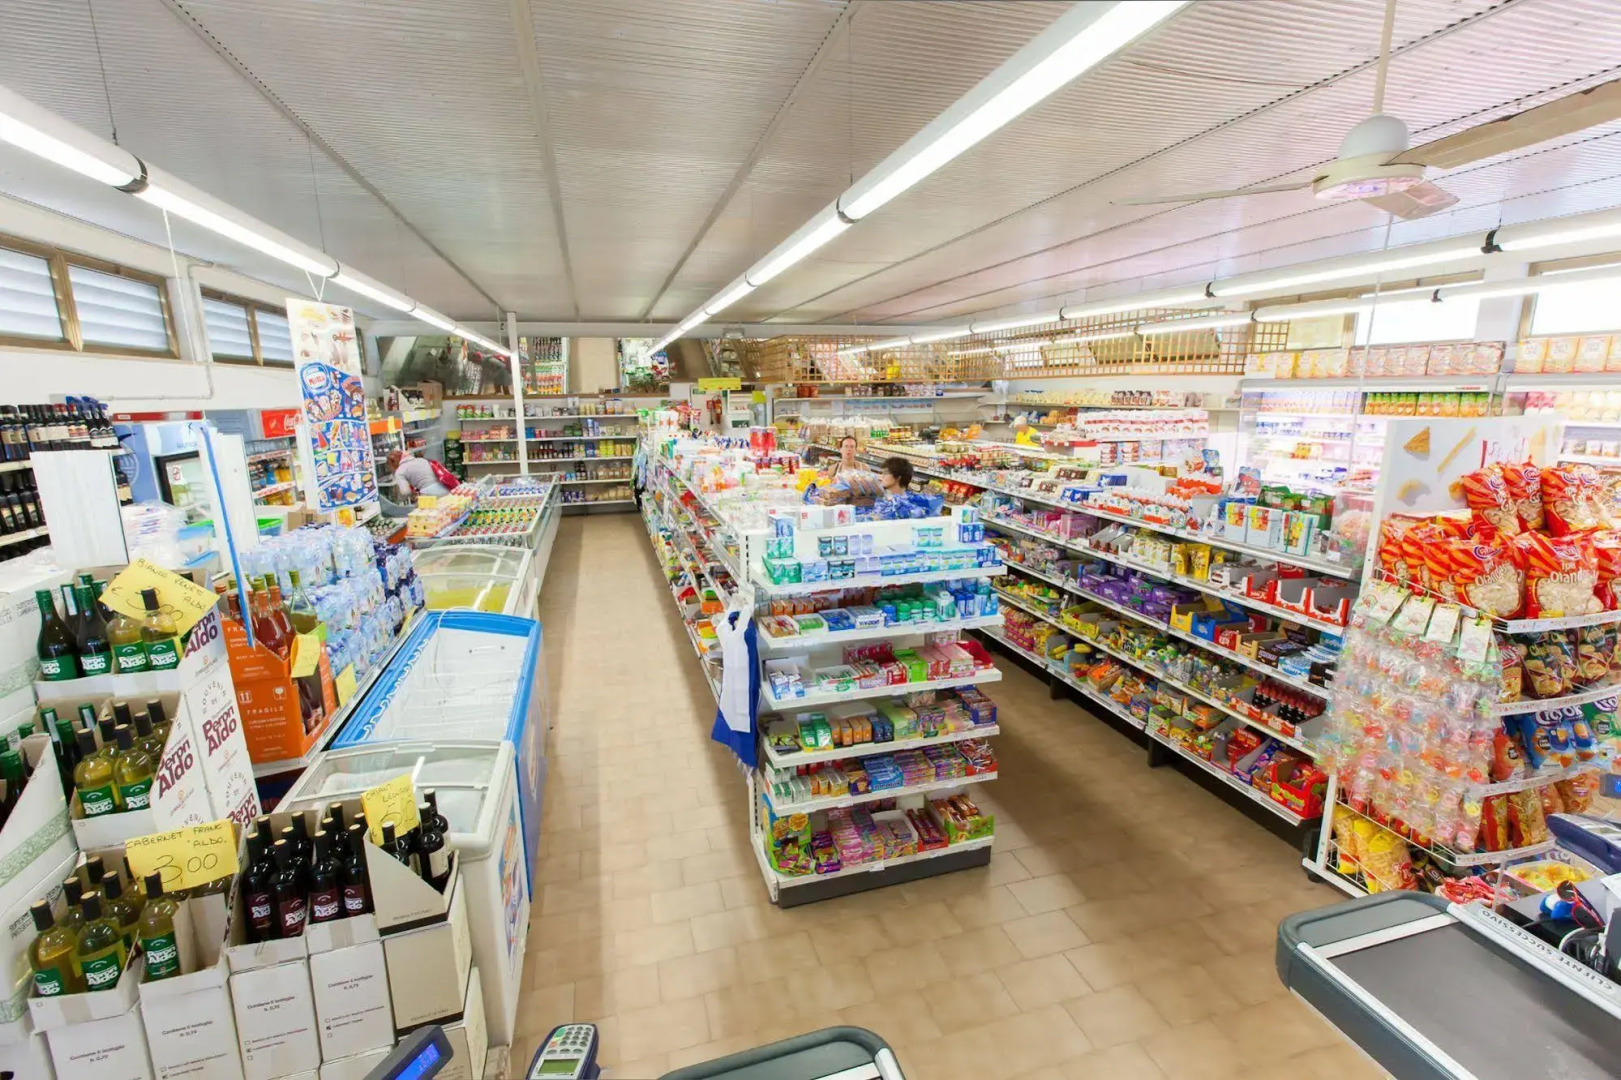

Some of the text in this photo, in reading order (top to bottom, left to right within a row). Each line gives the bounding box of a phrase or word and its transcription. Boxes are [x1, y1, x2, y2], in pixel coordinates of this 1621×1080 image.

[247, 706, 284, 715] FRAGILE
[208, 718, 237, 757] Aldo
[157, 753, 193, 800] Aldo
[126, 830, 183, 849] CABERNET
[1482, 910, 1612, 990] CLIENTE SUCCESSIVO
